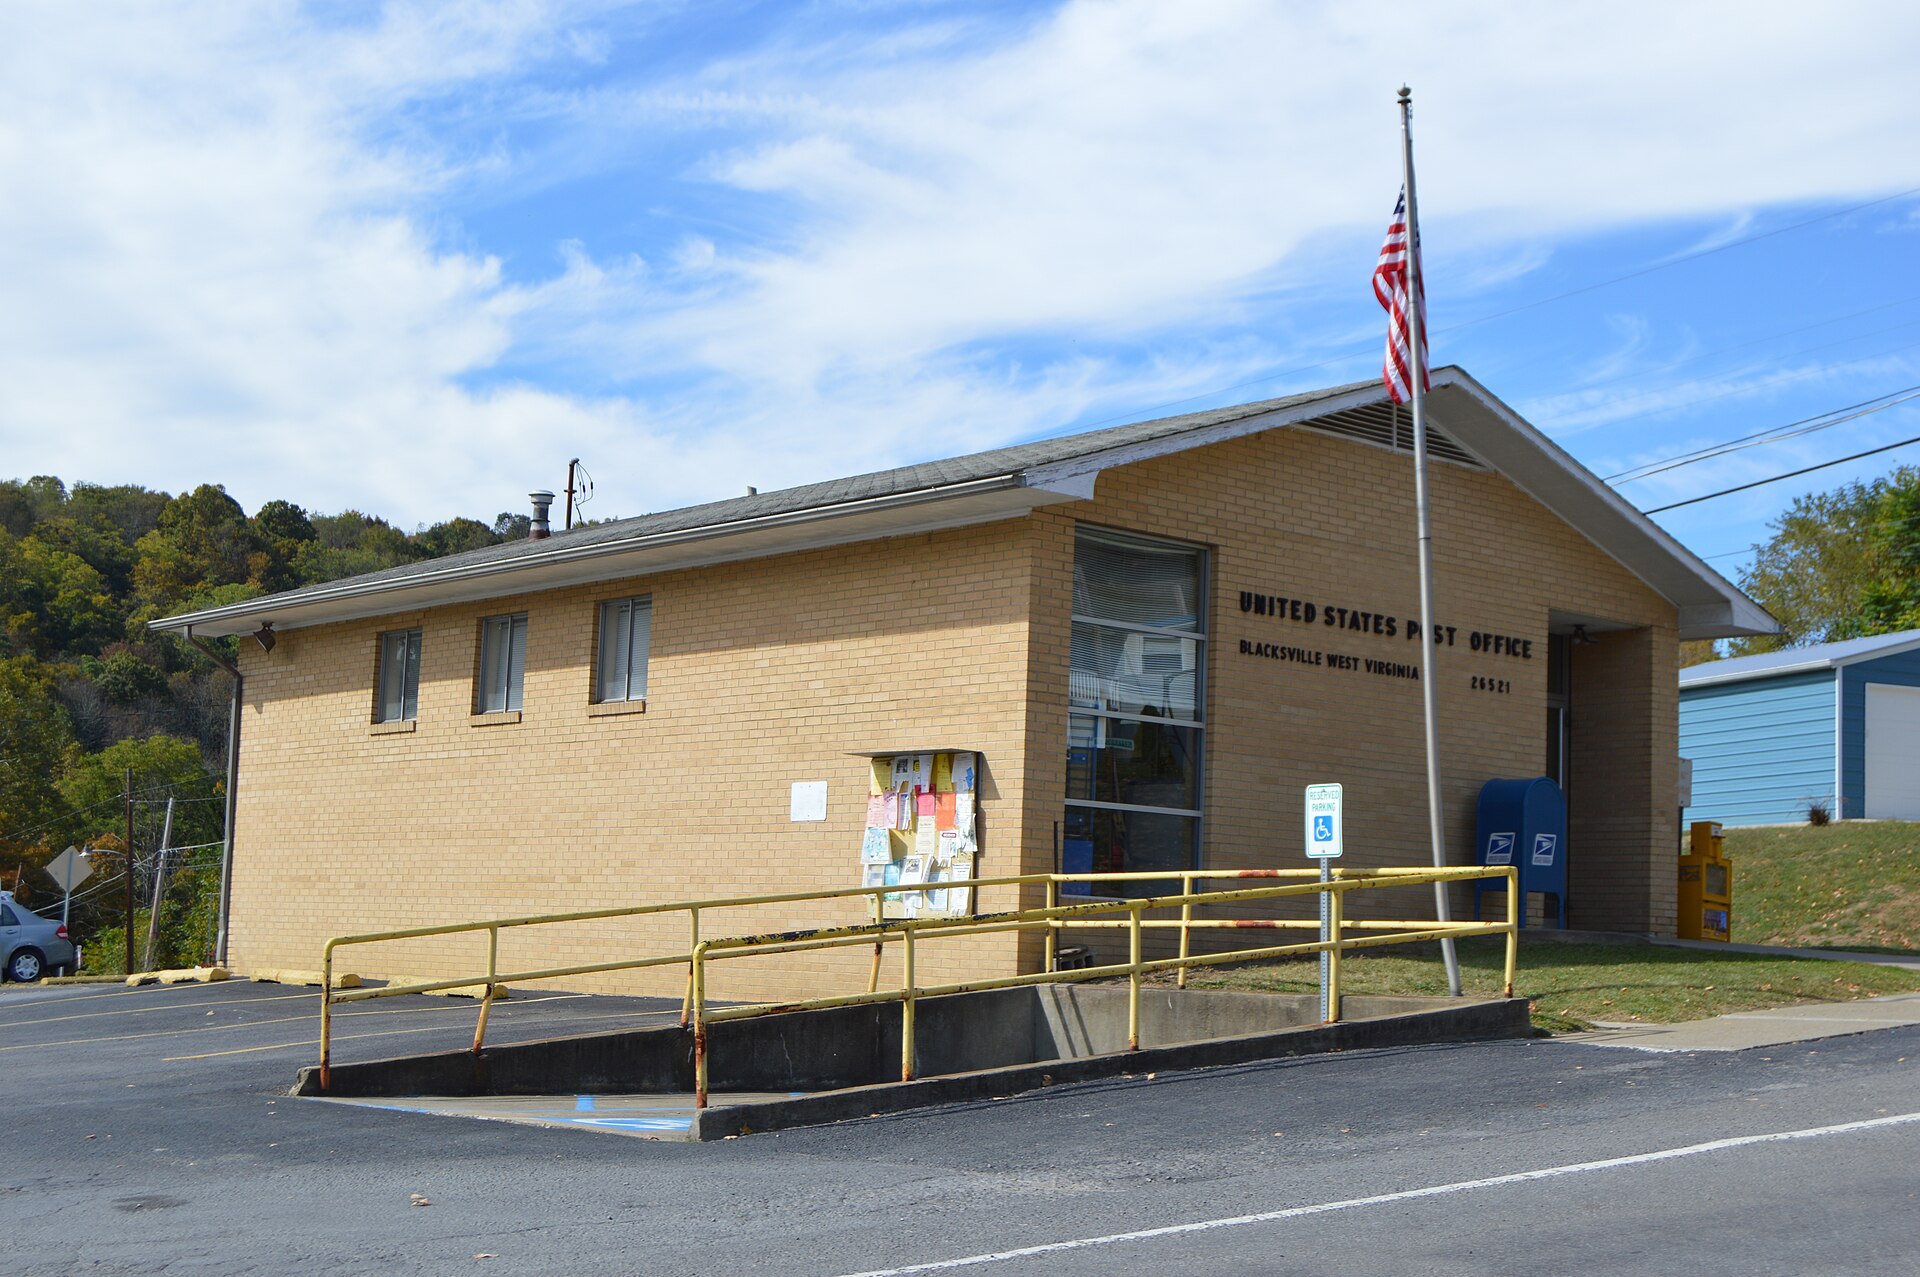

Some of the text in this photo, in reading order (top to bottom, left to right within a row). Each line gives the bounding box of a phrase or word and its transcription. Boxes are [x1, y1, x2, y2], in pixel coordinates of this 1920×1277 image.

[1240, 591, 1532, 659] UNITED STATES PST OFFICE
[1239, 639, 1510, 694] BLACKSVILLE WEST VIRGINIA 26521
[1309, 790, 1339, 800] RESERVED
[1311, 802, 1336, 812] PARKING
